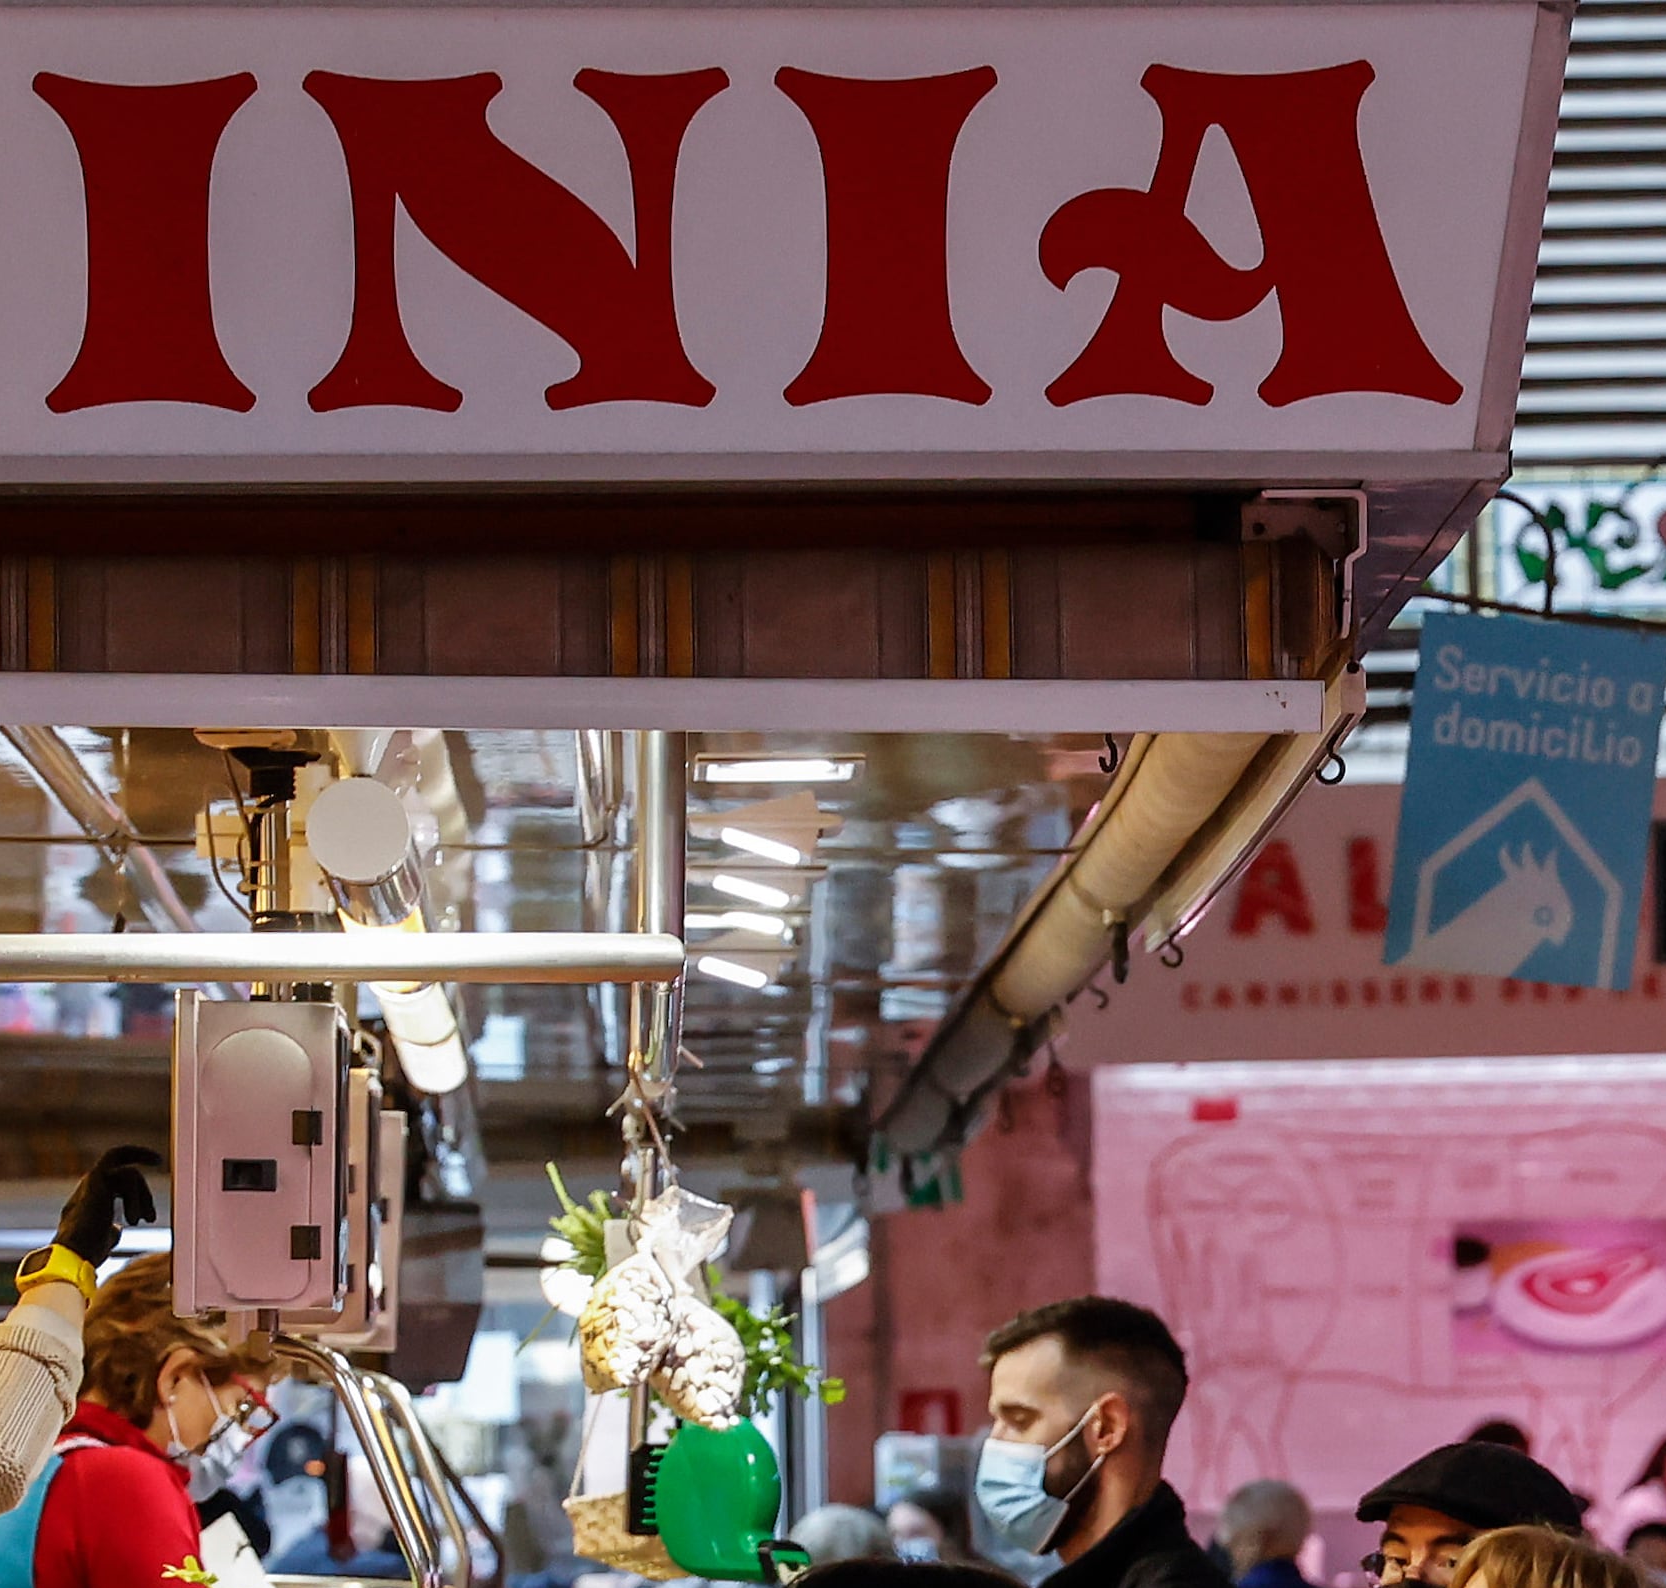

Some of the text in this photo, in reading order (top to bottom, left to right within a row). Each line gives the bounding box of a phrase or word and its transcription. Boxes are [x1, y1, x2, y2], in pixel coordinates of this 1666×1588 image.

[1434, 644, 1656, 714] Servicio a
[1434, 700, 1643, 767] domicilio
